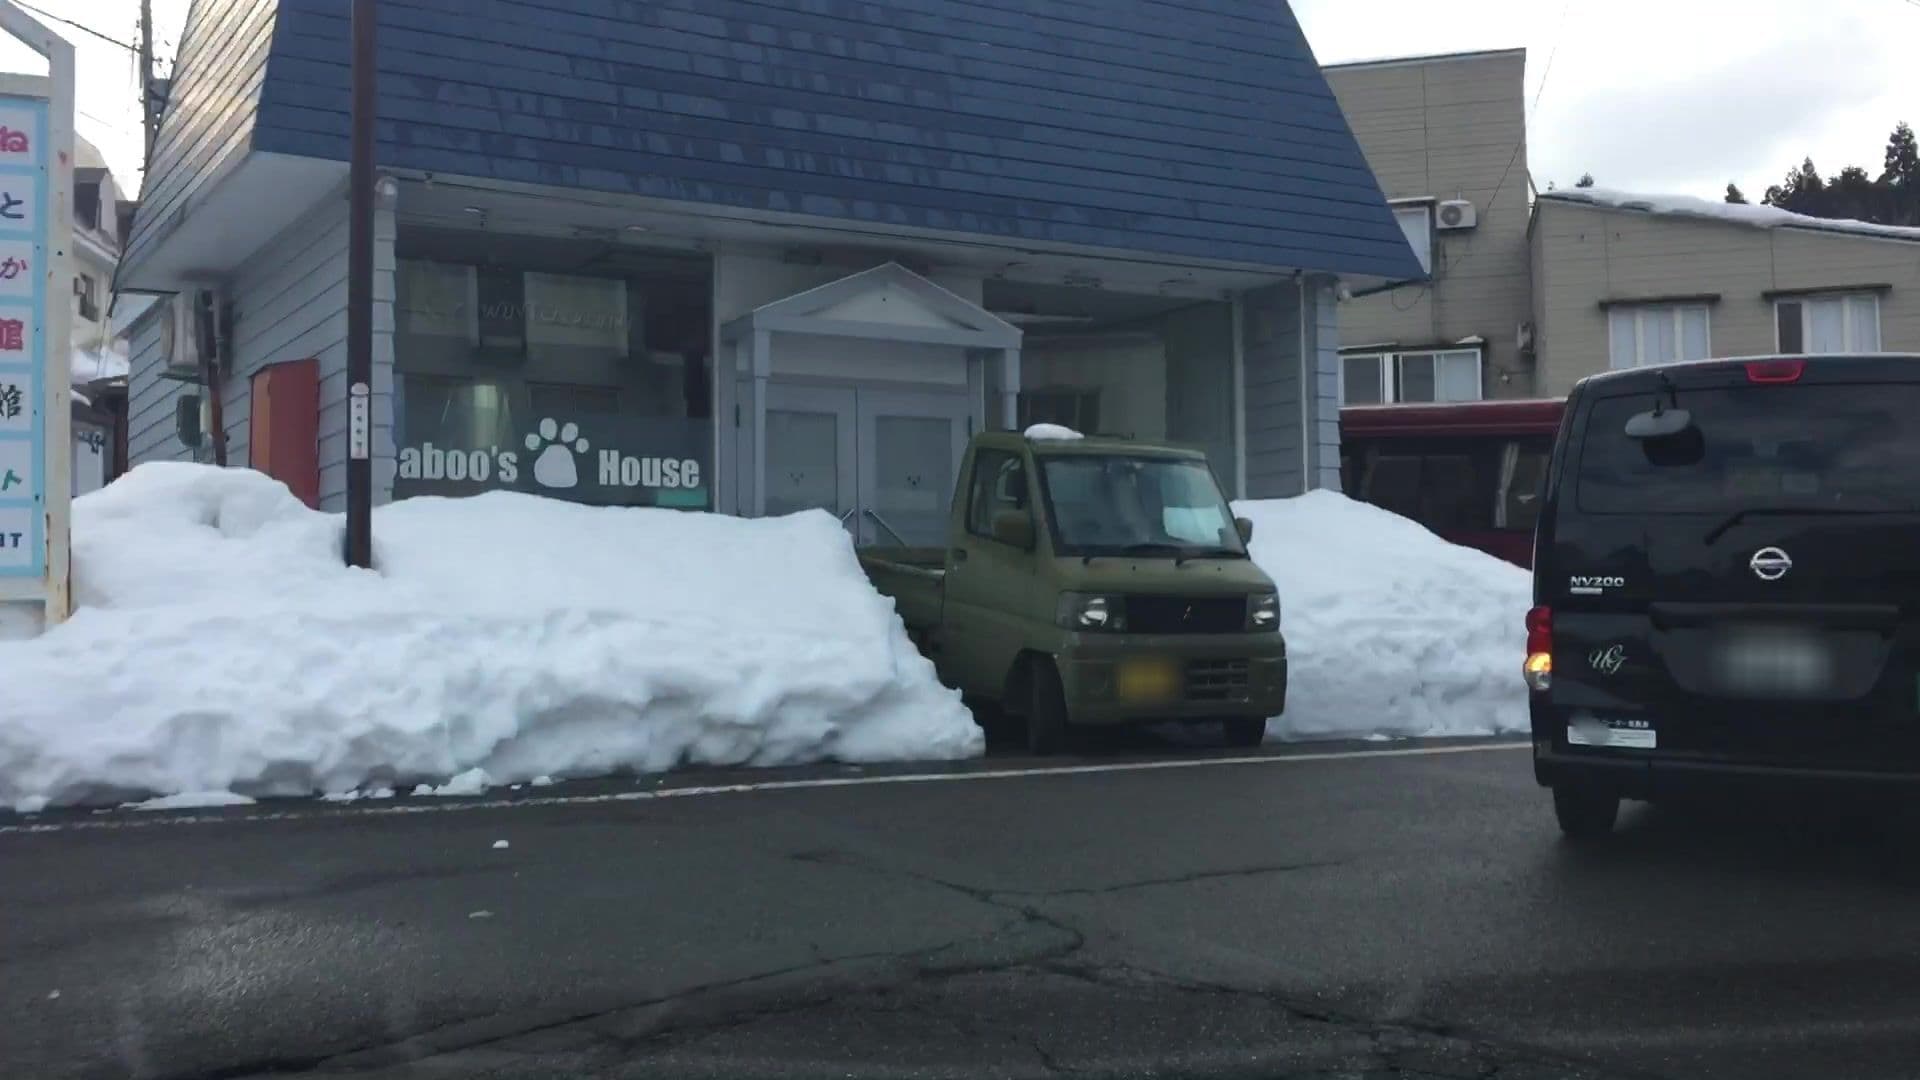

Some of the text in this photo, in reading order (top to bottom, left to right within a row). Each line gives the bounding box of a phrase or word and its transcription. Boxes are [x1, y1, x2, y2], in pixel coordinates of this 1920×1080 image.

[391, 442, 700, 488] aboo's House
[1570, 576, 1625, 587] NV200
